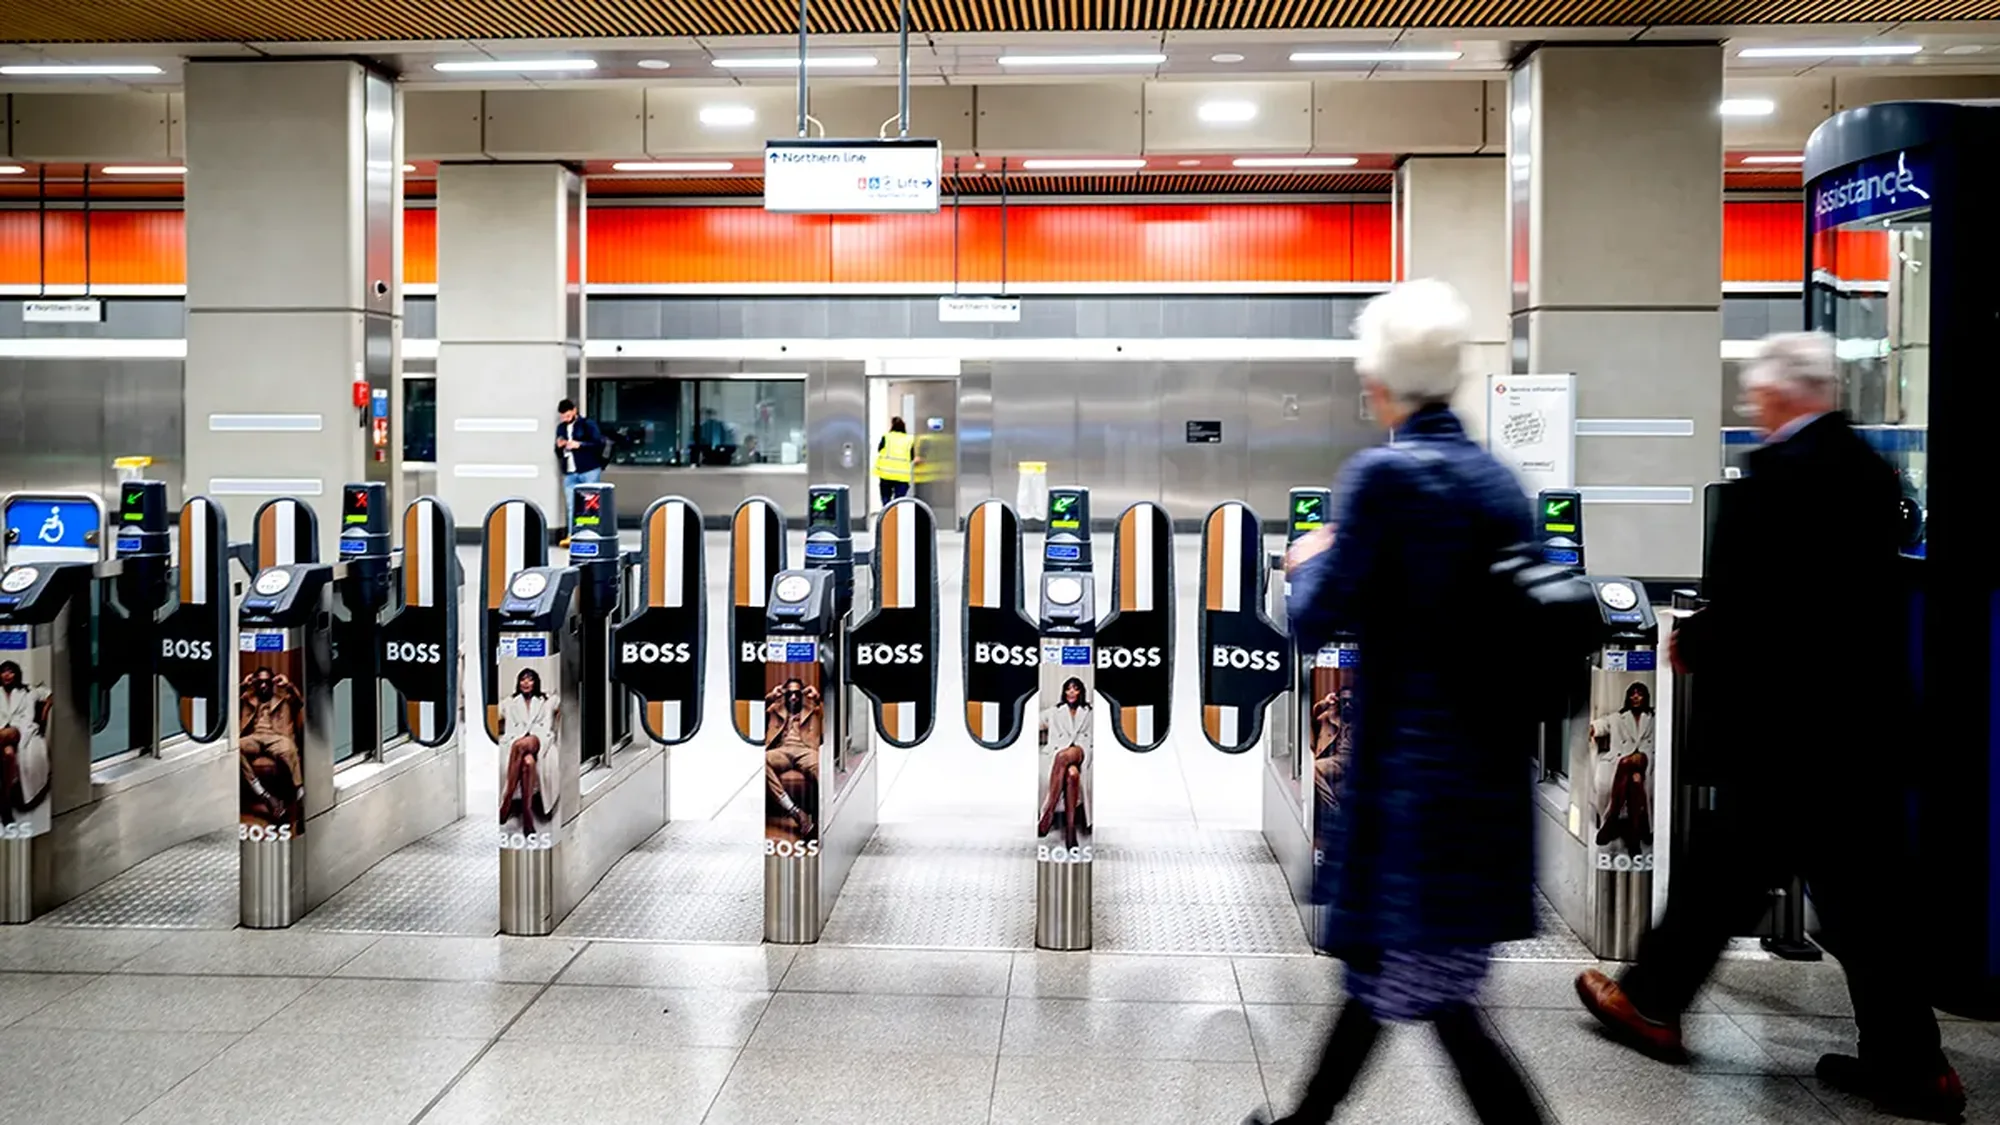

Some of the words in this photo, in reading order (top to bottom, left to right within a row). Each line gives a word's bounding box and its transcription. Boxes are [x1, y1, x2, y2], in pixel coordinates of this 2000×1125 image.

[782, 152, 840, 164] Northern
[844, 152, 867, 164] line
[897, 178, 918, 189] Lift
[1815, 169, 1914, 217] Assistance
[162, 638, 212, 660] BOSS
[386, 642, 440, 663] BOSS
[622, 642, 690, 664] BOSS
[742, 642, 767, 663] BO
[857, 643, 923, 665] BOSS
[975, 642, 1039, 667] BOSS
[1097, 646, 1161, 669] BOSS
[1213, 647, 1280, 671] BOSS
[239, 823, 292, 841] BOSS
[499, 832, 551, 849] BOSS
[765, 839, 819, 857] BOSS
[1037, 845, 1092, 862] BOSS
[1598, 853, 1653, 871] BOSS
